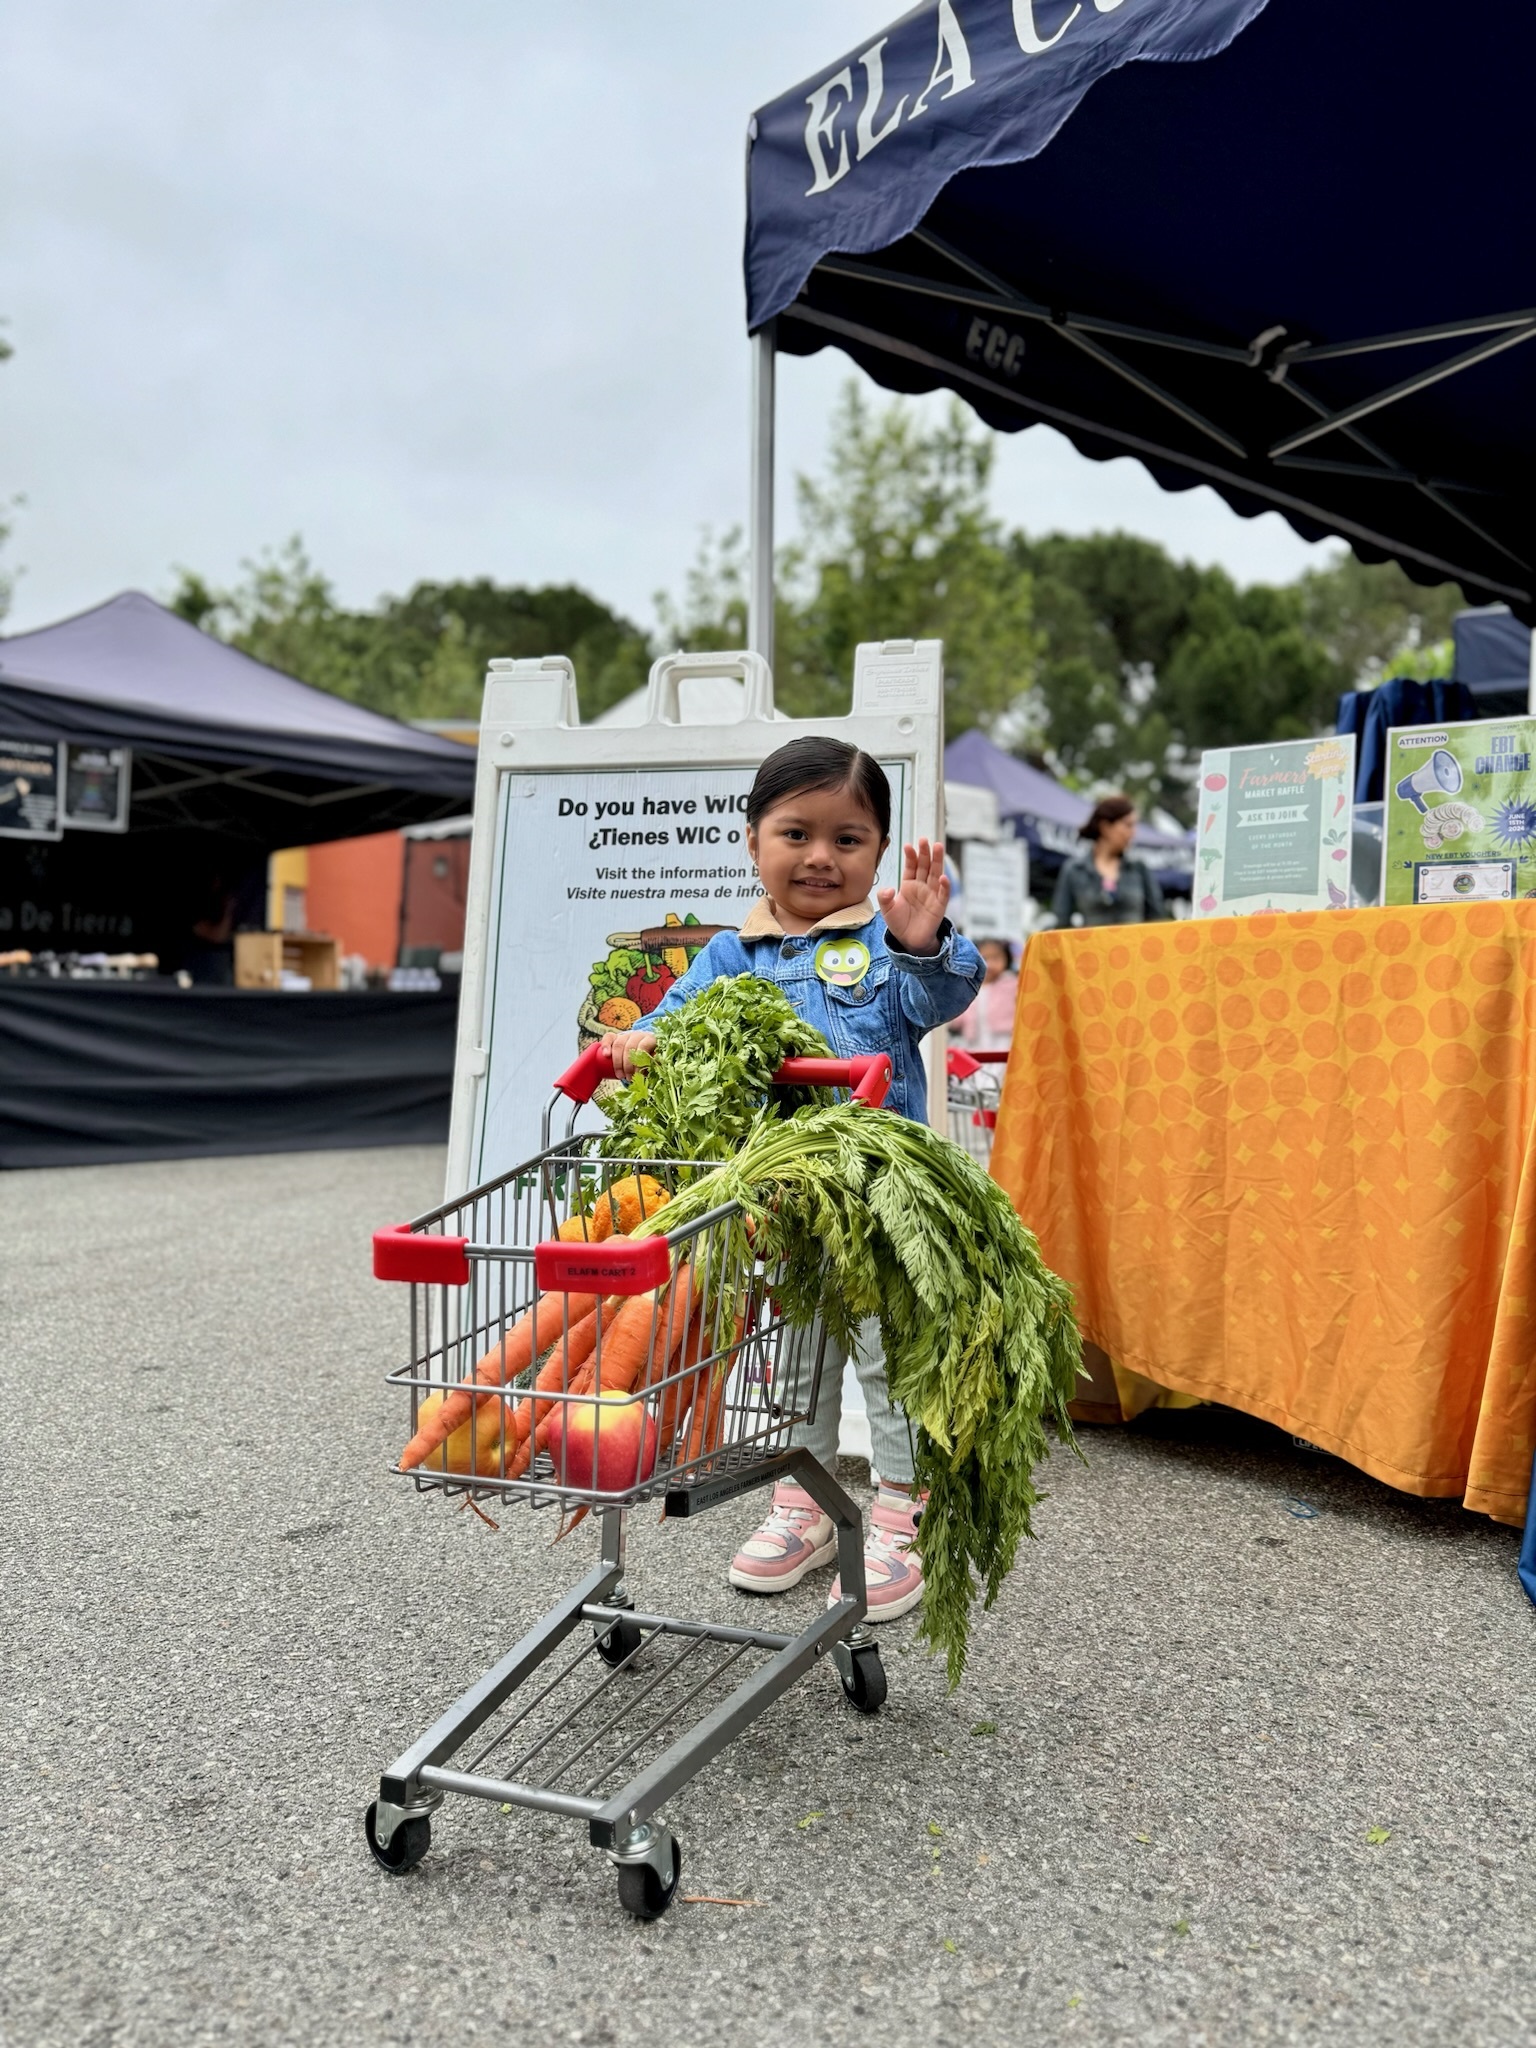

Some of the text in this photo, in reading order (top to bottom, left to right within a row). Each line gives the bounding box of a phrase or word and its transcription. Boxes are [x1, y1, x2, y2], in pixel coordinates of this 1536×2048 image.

[804, 0, 976, 197] ELA
[1398, 735, 1448, 747] ATTENTION
[1491, 735, 1516, 755] EBT
[1475, 752, 1532, 776] CHANGE
[1238, 766, 1309, 790] Farmers
[1244, 785, 1305, 799] MARKET RAFFLE
[558, 795, 750, 820] Do you have WIC
[1247, 810, 1298, 822] ASK TO JOIN
[589, 826, 741, 850] ¿Tienes WIC o
[1460, 850, 1502, 859] VOUCHERS
[596, 867, 628, 880] Visit
[631, 867, 656, 879] the
[660, 866, 747, 879] information
[567, 887, 607, 899] Visite
[611, 886, 666, 899] nuestra
[670, 888, 709, 899] mesa
[714, 886, 732, 899] de
[20, 900, 54, 933] De
[567, 1267, 636, 1276] ELAFM CART 2
[696, 1495, 709, 1505] EAST
[709, 1492, 719, 1501] LOS
[719, 1484, 740, 1497] ANGELES
[740, 1475, 760, 1490] FARMERS
[761, 1469, 777, 1480] MARKET
